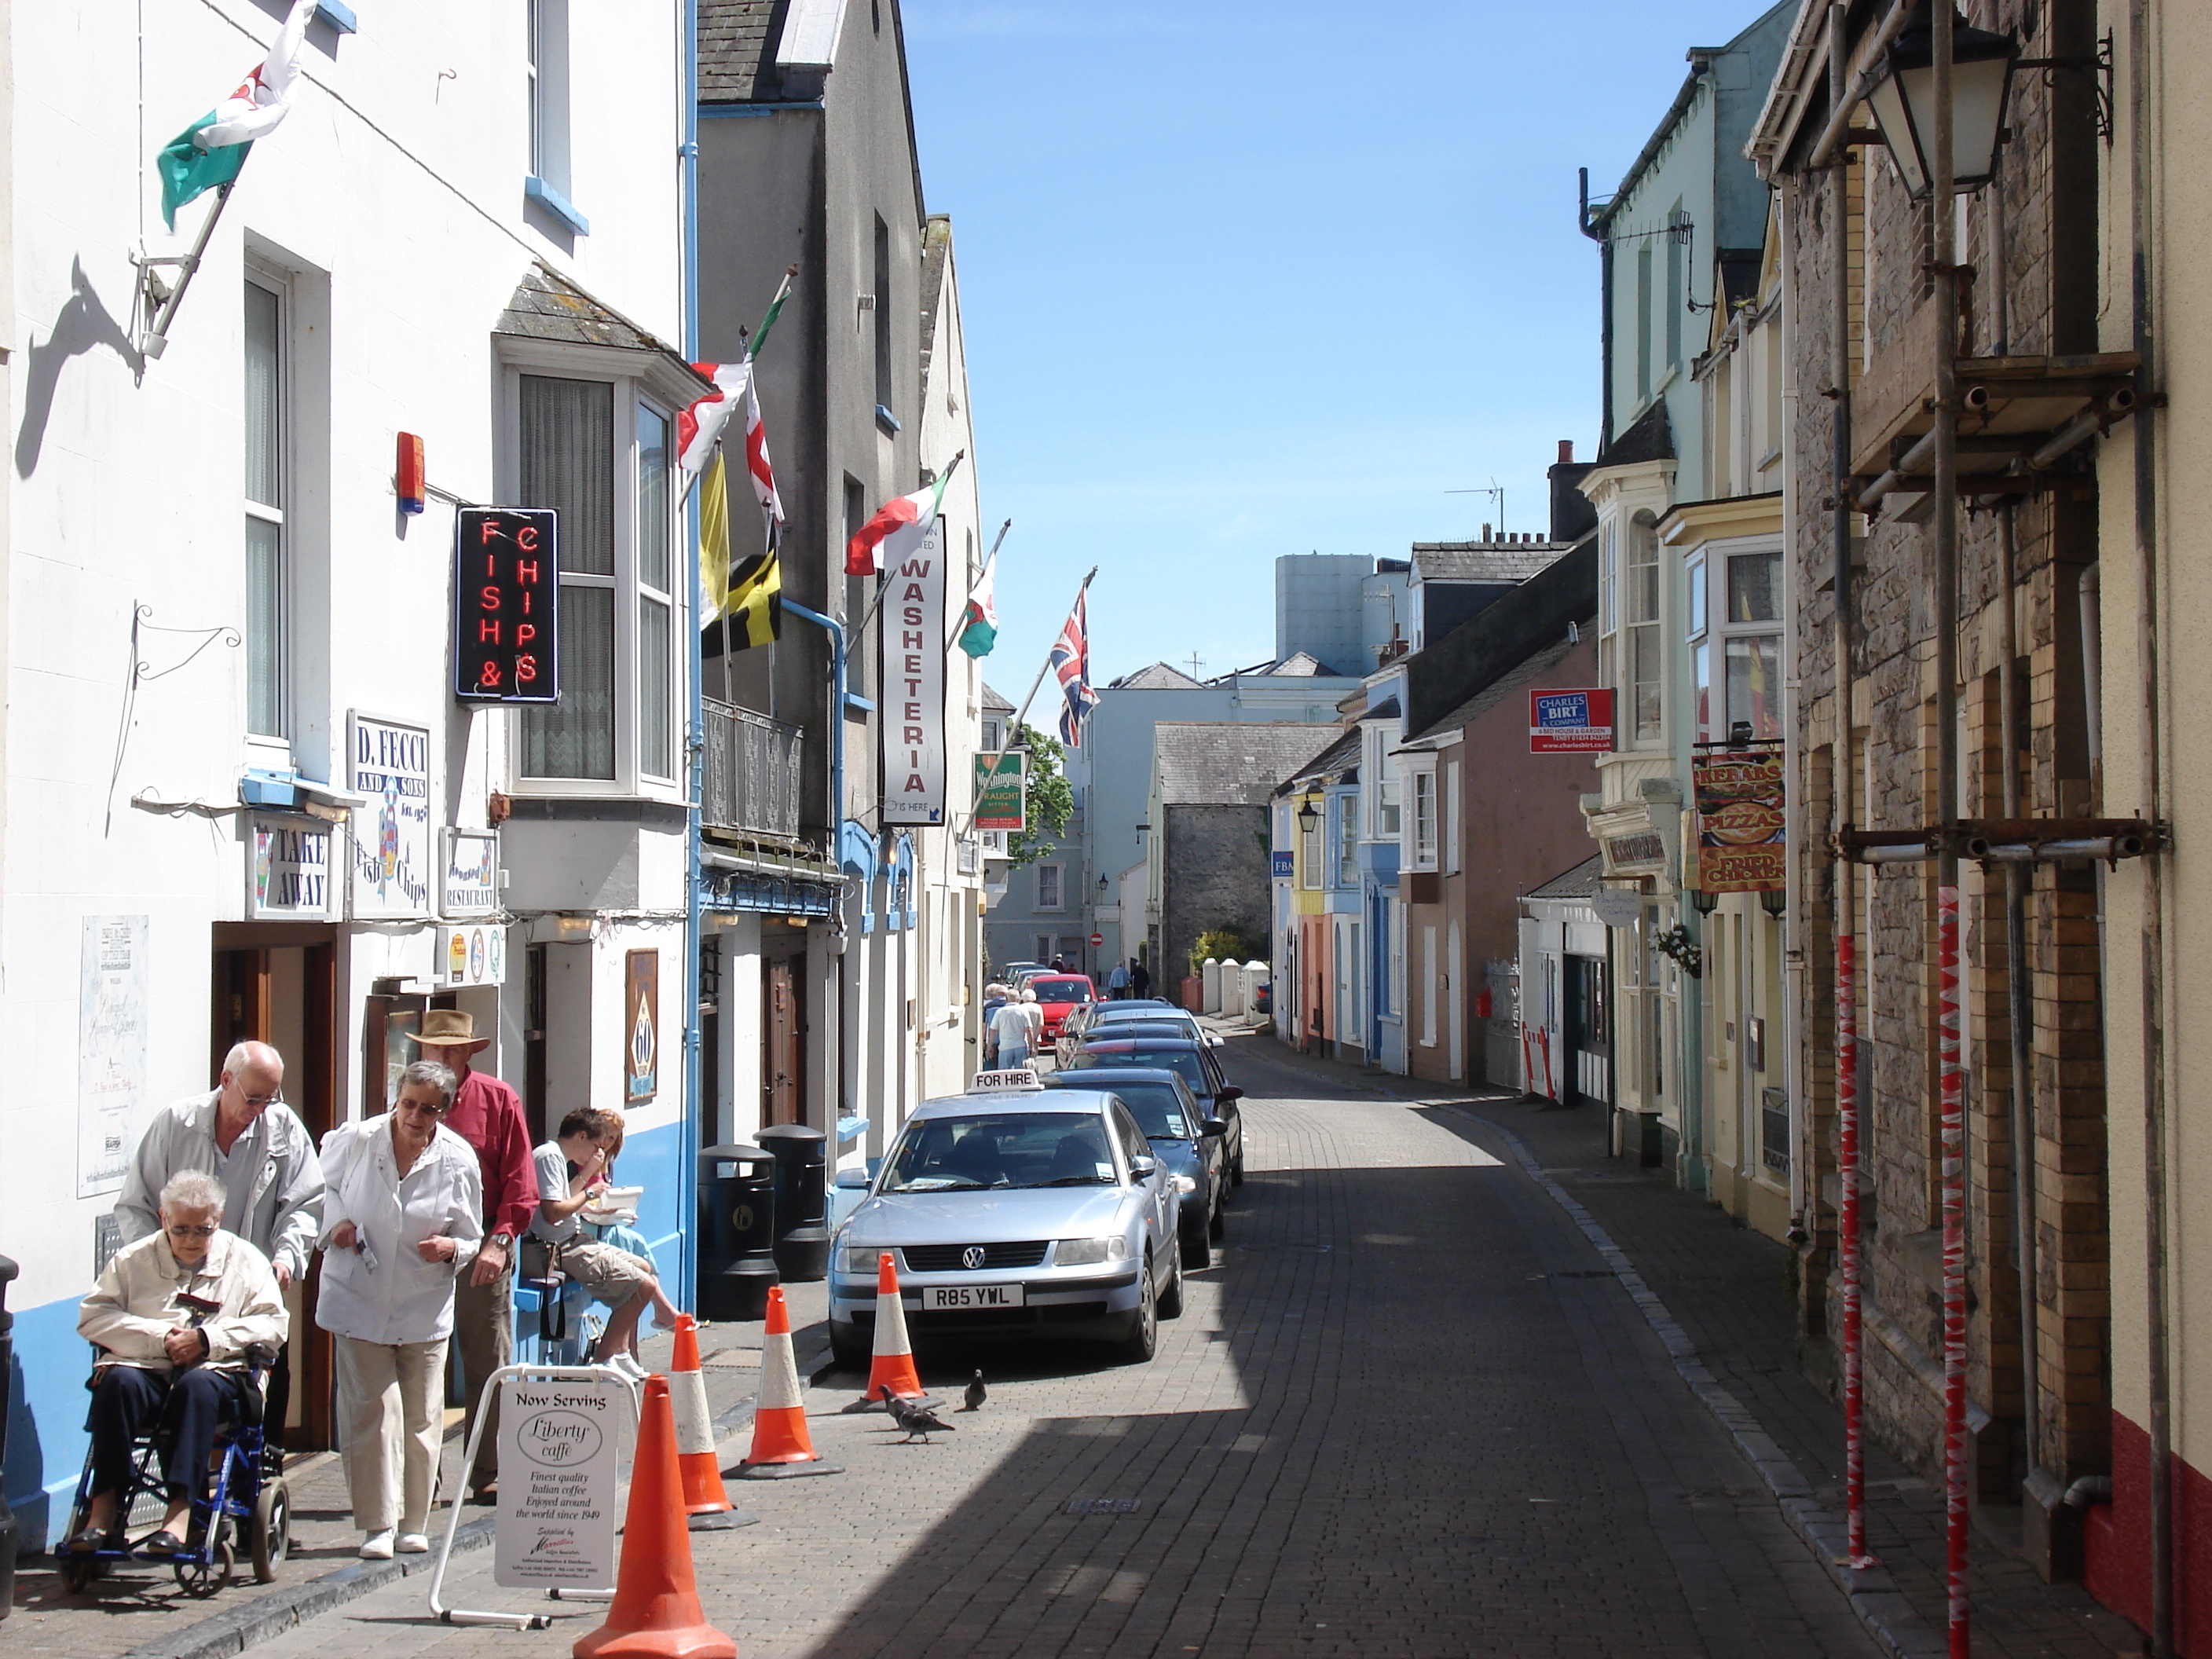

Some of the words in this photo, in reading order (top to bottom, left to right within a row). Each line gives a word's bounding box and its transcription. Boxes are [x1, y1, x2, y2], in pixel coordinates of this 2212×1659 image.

[479, 522, 500, 645] FISH
[517, 526, 538, 681] CHIPS
[481, 660, 501, 686] &
[901, 558, 931, 793] WASHETERIA
[1540, 696, 1584, 709] CHARLES
[1548, 706, 1578, 720] BIRT
[1550, 717, 1586, 727] COMPANY
[357, 726, 375, 765] D.
[378, 729, 425, 772] FECCI
[976, 771, 1021, 788] Wohington
[1698, 765, 1782, 786] KEBABS
[360, 773, 383, 793] AND
[401, 777, 424, 797] SONS
[909, 803, 928, 811] HERE
[1702, 811, 1785, 831] PIZZAS
[277, 828, 325, 865] TAKE
[1719, 855, 1776, 870] FRIED
[357, 838, 380, 884] Fish
[397, 859, 426, 909] Chips
[1708, 867, 1785, 882] CHICKEN
[277, 871, 324, 906] AWAY
[447, 889, 493, 907] RESTAURANT
[976, 1074, 1001, 1087] FOR
[1005, 1072, 1032, 1085] HIRE
[936, 1289, 970, 1306] R85
[976, 1287, 1009, 1304] YWL
[516, 1393, 549, 1406] Now
[554, 1393, 606, 1410] Serving
[530, 1471, 556, 1481] Finest
[558, 1473, 589, 1484] quality
[532, 1484, 559, 1494] Italian
[562, 1485, 587, 1496] coffee
[526, 1496, 558, 1508] Enjoyed
[560, 1498, 591, 1507] around
[516, 1508, 529, 1518] the
[531, 1510, 555, 1518] world
[557, 1510, 579, 1520] since
[581, 1511, 600, 1520] 1949
